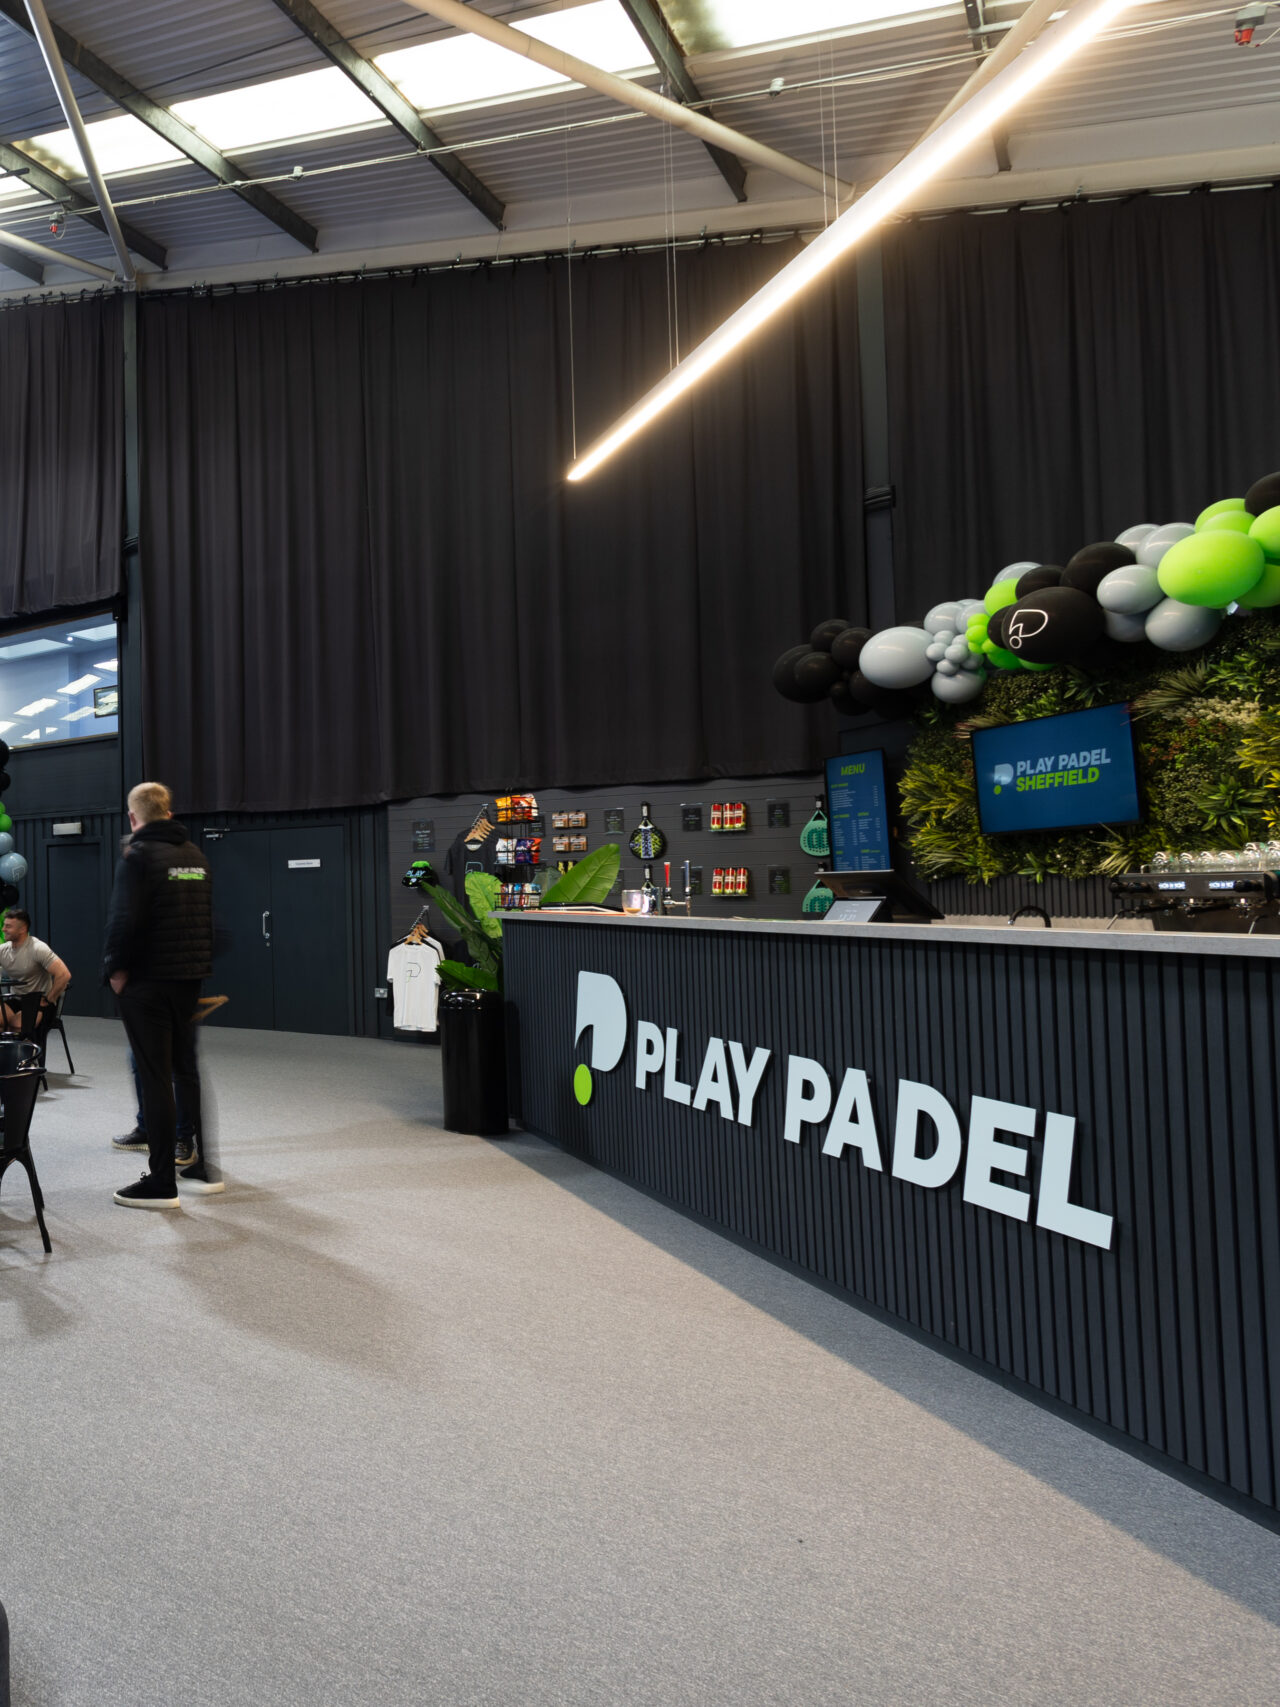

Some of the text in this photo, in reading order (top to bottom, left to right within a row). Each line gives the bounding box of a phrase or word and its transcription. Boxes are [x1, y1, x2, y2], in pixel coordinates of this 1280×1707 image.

[840, 763, 865, 776] MENU
[1016, 748, 1111, 776] PLAY PADEL
[1016, 767, 1100, 792] SHEFFIELD
[635, 1020, 1114, 1250] PLAY PADEL
